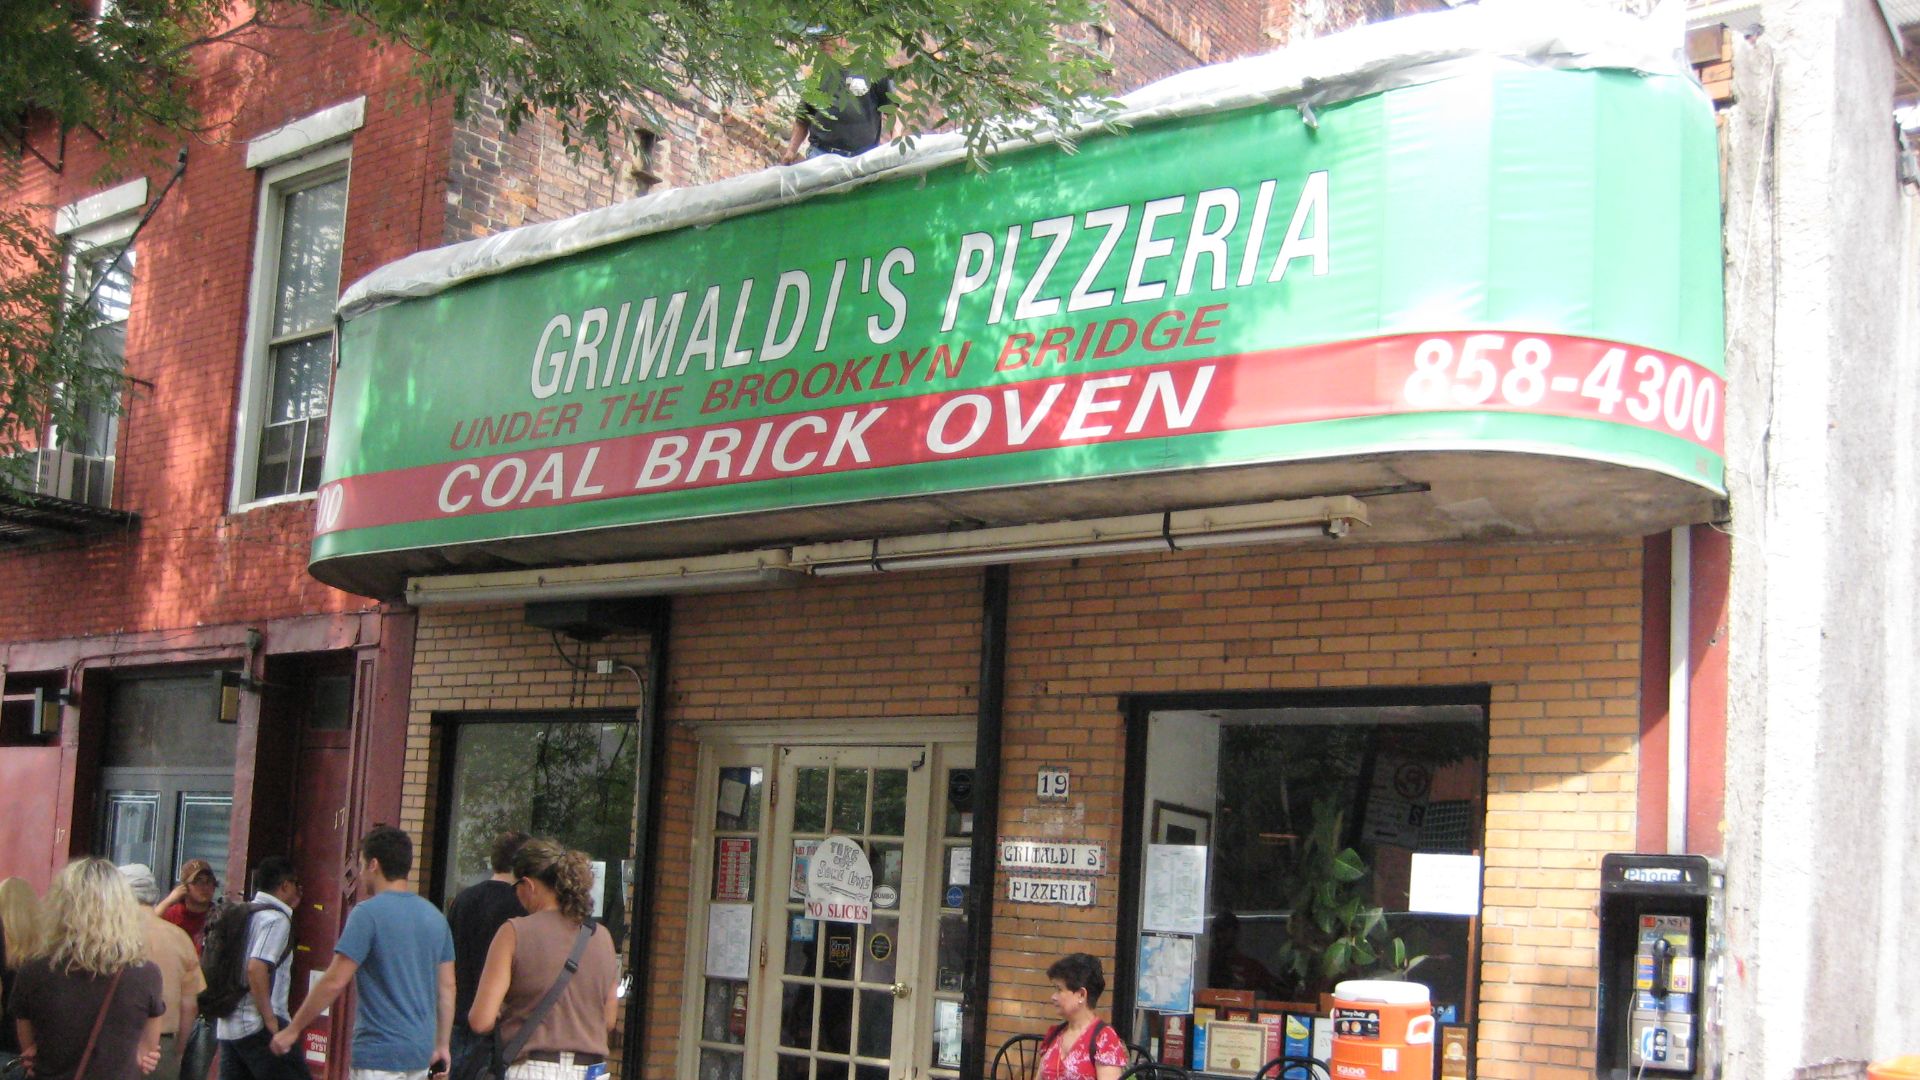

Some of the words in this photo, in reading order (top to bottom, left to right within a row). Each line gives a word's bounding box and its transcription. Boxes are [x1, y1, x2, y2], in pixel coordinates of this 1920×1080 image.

[531, 246, 916, 399] GRIMALDI'S
[940, 170, 1330, 333] PIZZERIA
[449, 403, 583, 452] UNDER
[600, 386, 685, 427] THE
[700, 342, 971, 416] BROOKLYN
[994, 303, 1229, 373] BRIDGE
[1403, 334, 1716, 442] 858-4300
[437, 447, 605, 514] COAL
[635, 406, 888, 490] BRICK
[926, 365, 1217, 455] OVEN
[1041, 774, 1068, 795] 19
[1629, 867, 1679, 881] Phone
[873, 892, 895, 900] DUMBO
[1012, 881, 1087, 902] PIZZERIA
[807, 901, 823, 917] NO
[827, 903, 869, 921] SLICES
